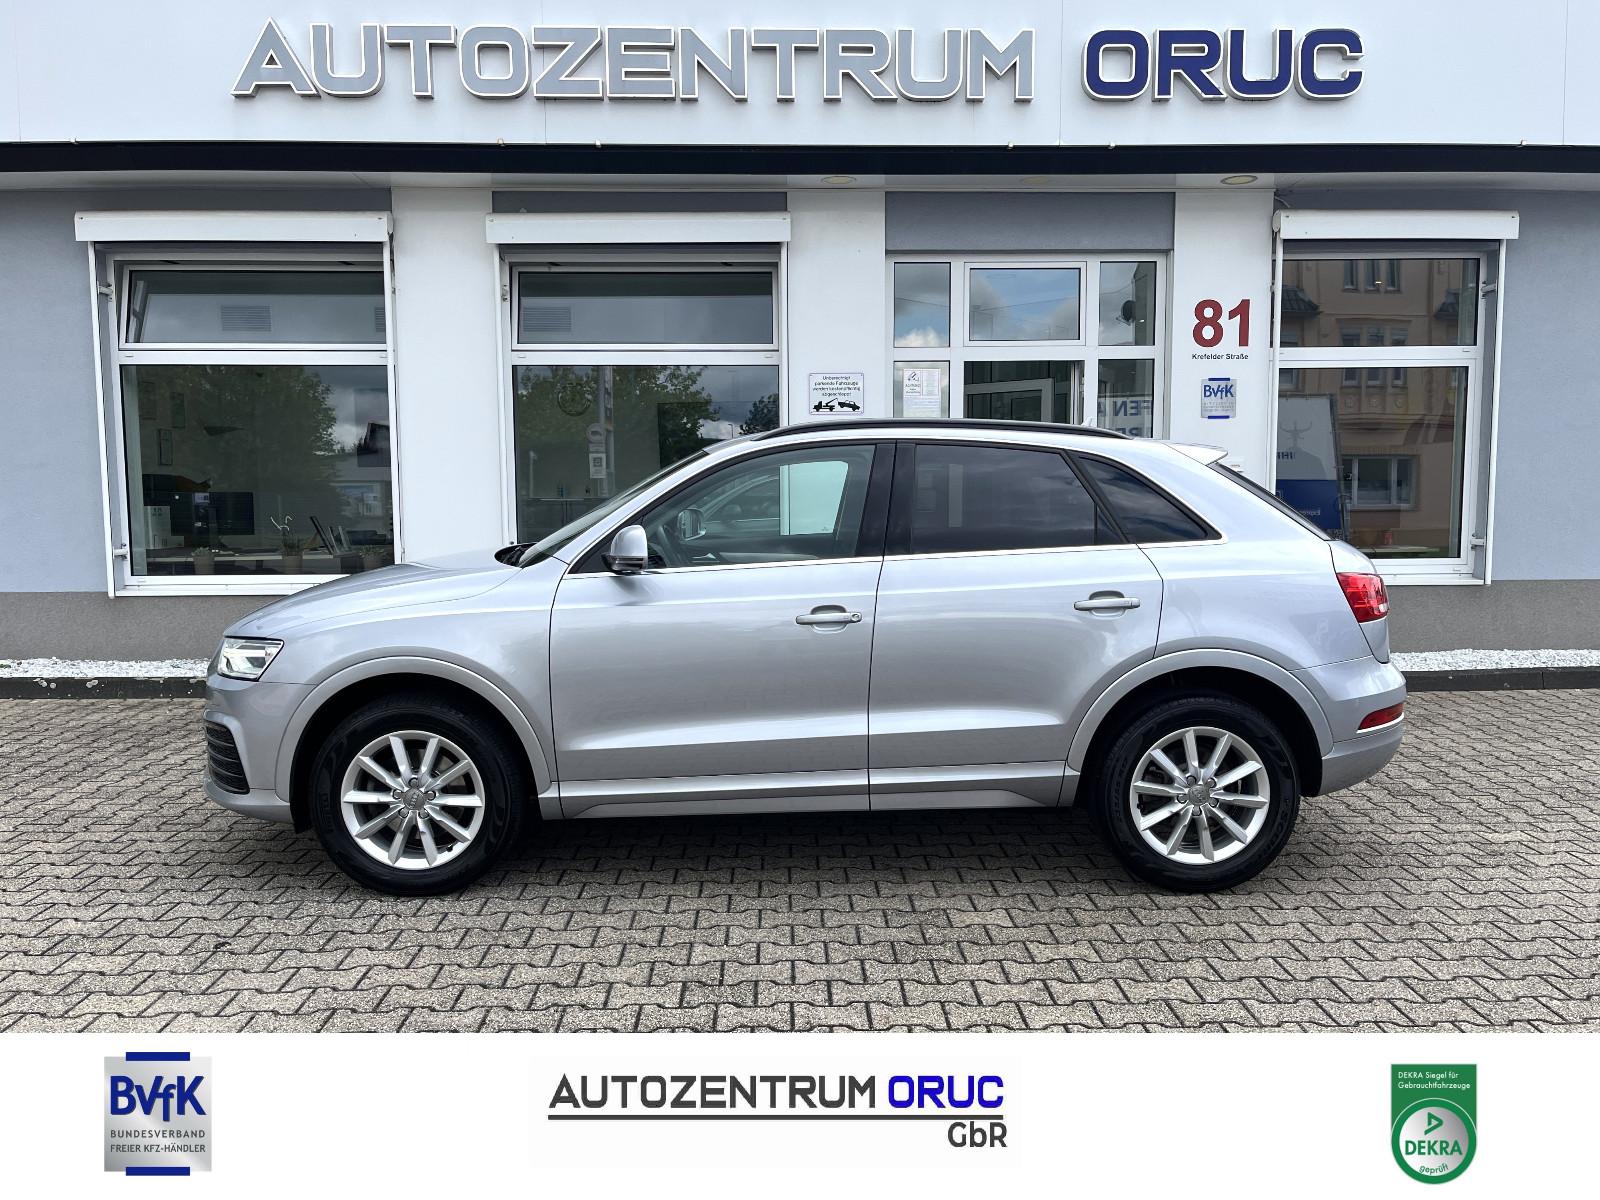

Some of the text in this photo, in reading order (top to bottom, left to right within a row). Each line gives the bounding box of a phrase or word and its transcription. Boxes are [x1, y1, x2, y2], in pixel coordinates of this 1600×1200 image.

[230, 17, 1364, 102] AUTOZENTRUM ORUC
[1192, 299, 1250, 348] 81
